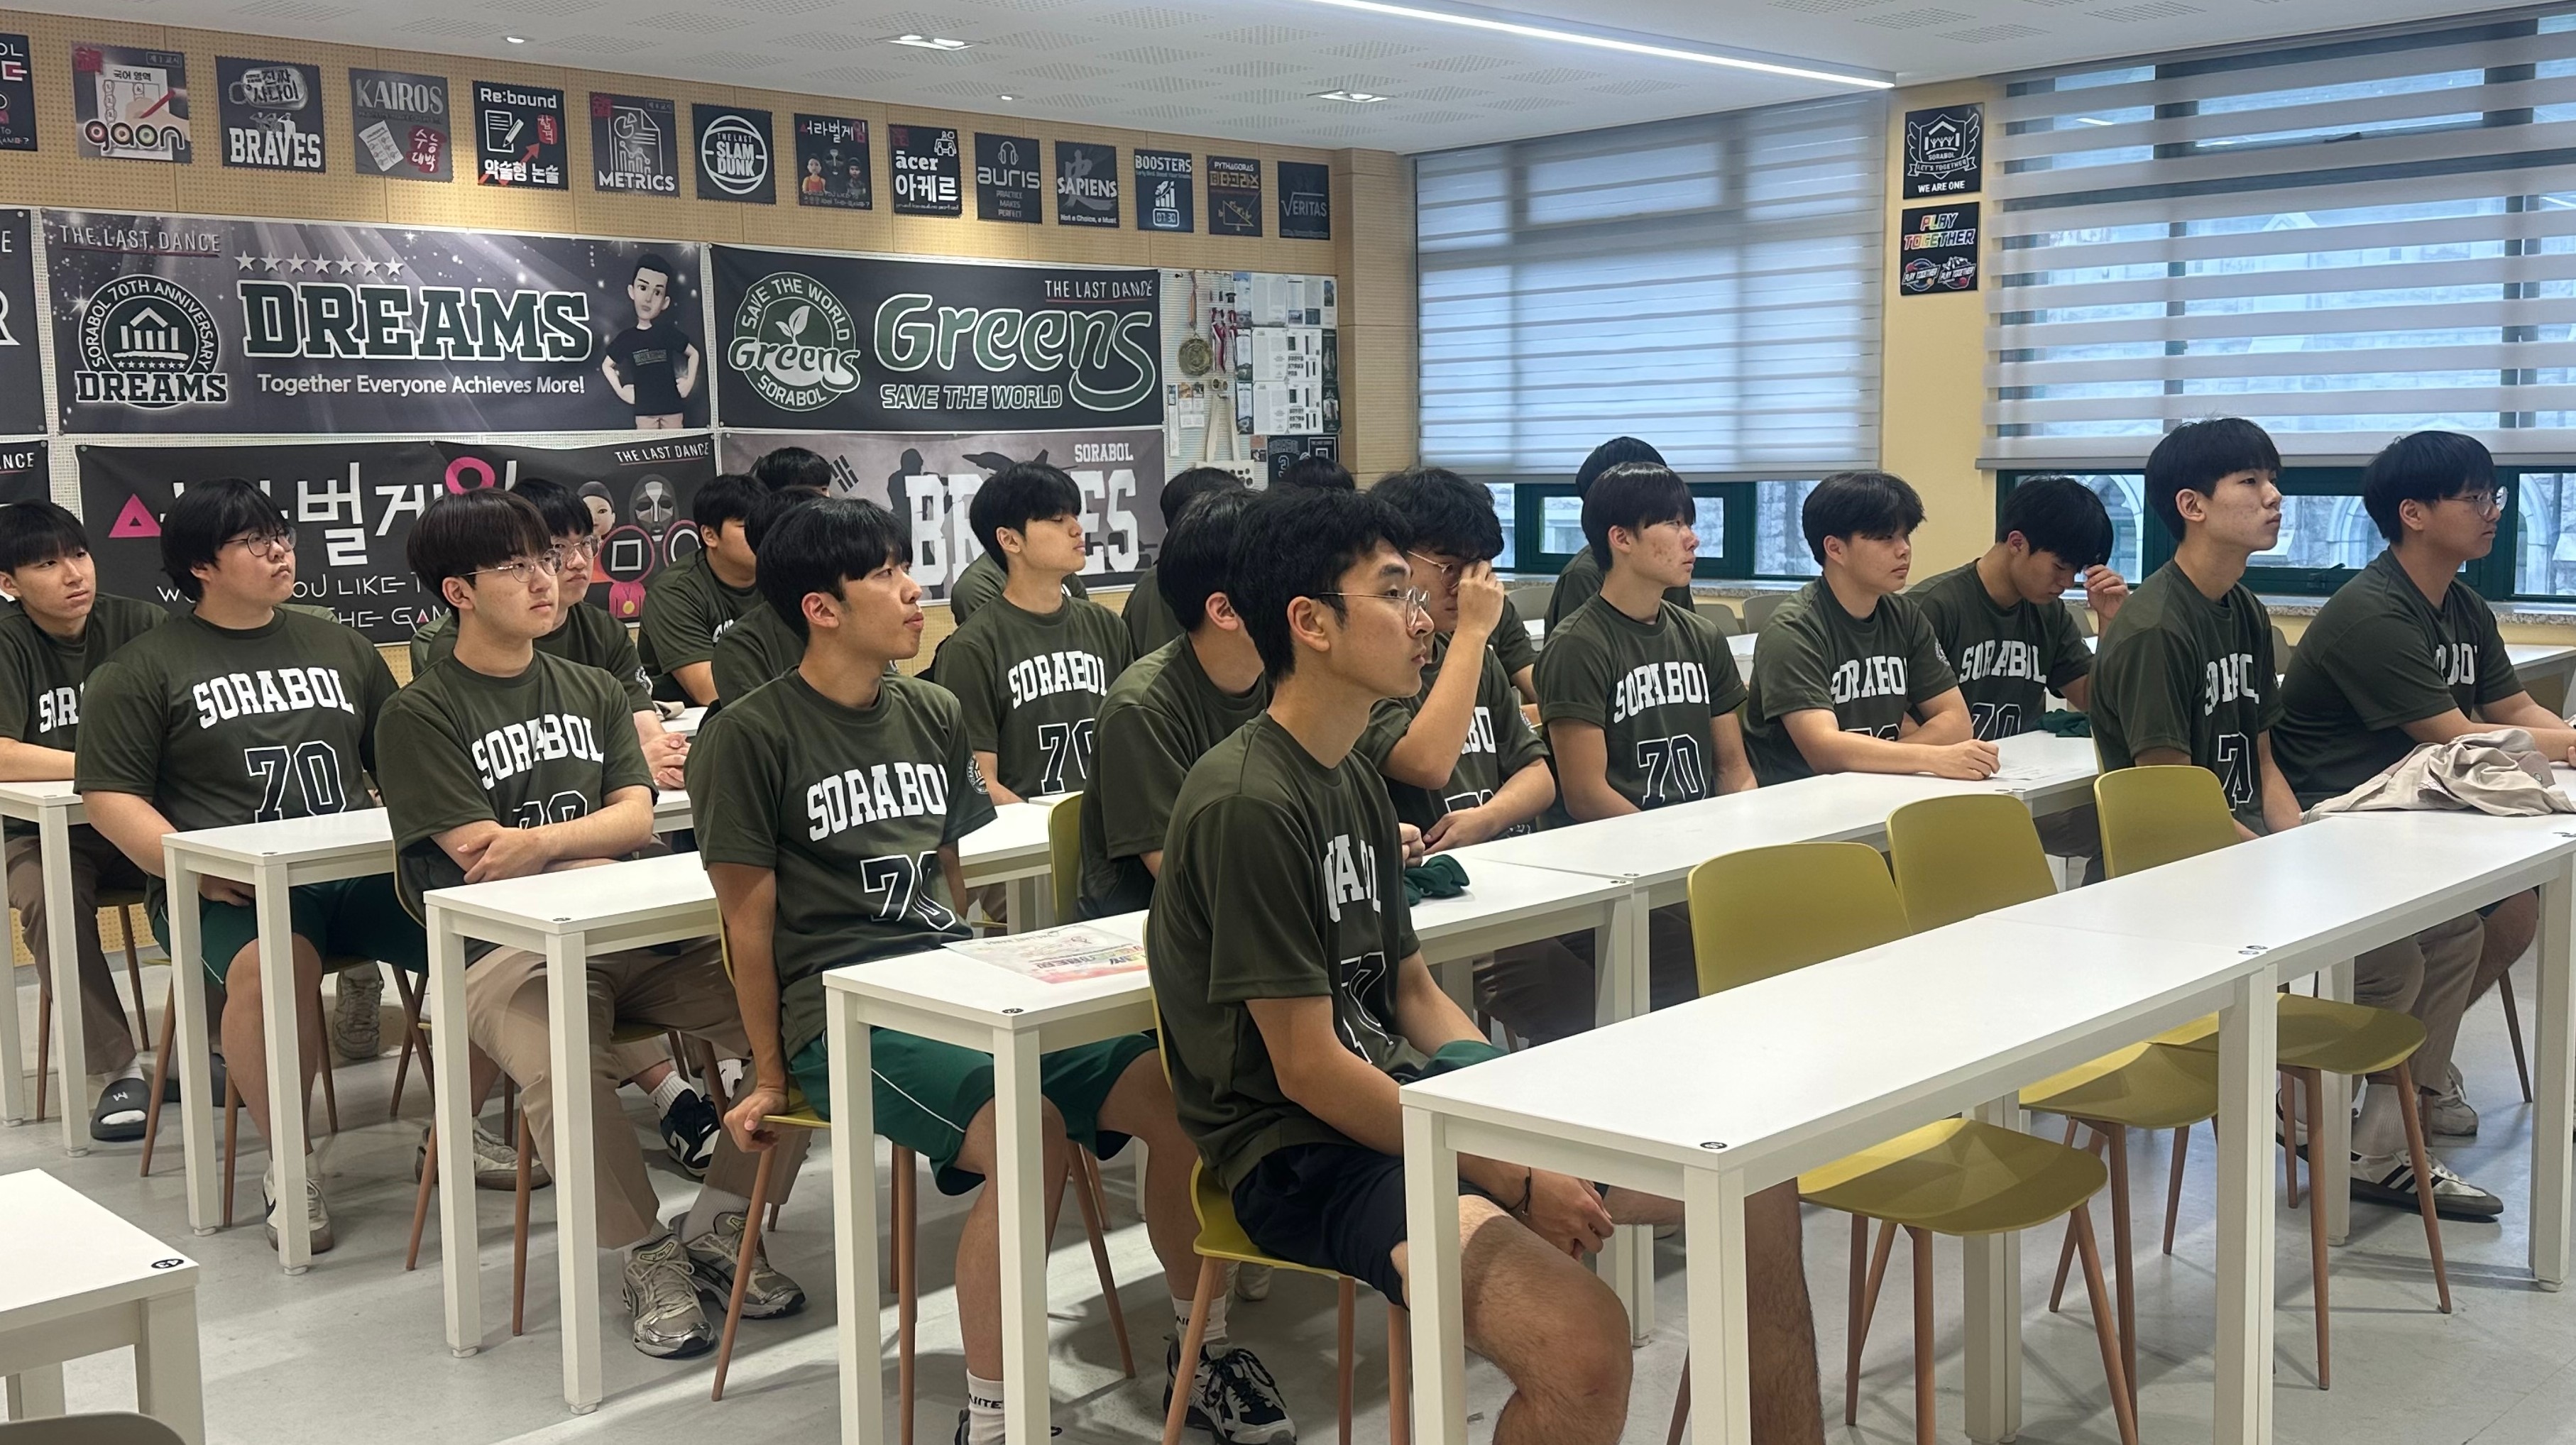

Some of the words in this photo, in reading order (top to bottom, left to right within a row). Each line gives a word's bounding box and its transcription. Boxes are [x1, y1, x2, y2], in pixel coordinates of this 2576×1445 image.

[114, 70, 131, 79] 국어
[262, 68, 291, 86] 진짜
[253, 80, 300, 102] 사나이
[356, 78, 444, 115] KAIROS
[480, 87, 557, 109] Re:bound
[229, 127, 322, 168] BRAVES
[414, 128, 439, 154] 수능
[717, 133, 732, 141] THE
[733, 134, 752, 143] LAST
[412, 151, 437, 172] 대박
[716, 141, 755, 160] SLAM
[484, 159, 527, 182] 약술형
[532, 163, 559, 185] 논술
[717, 157, 755, 177] DUNK
[1135, 155, 1192, 172] BOOSTERS
[1936, 159, 1967, 171] TOGETHER
[598, 170, 675, 192] METRICS
[895, 174, 958, 203] 아케르
[977, 166, 1041, 189] auris
[1057, 177, 1117, 198] SAPIENS
[1918, 185, 1931, 193] WE
[1931, 182, 1948, 192] ARE
[1949, 180, 1966, 190] ONE
[1920, 212, 1958, 231] PLAY
[60, 224, 94, 245] THE
[104, 231, 149, 250] LAST
[159, 232, 221, 252] DANCE
[1904, 229, 1976, 251] TOGETHER
[1045, 280, 1070, 297] THE
[1076, 280, 1107, 298] LAST
[1112, 280, 1153, 297] DANCE
[237, 280, 593, 362] DREAMS
[742, 286, 771, 329] SAVE
[771, 278, 804, 295] THE
[808, 283, 850, 341] WORLD
[85, 300, 111, 368] SORABOL
[107, 280, 150, 301] 70TH
[154, 282, 216, 371] ANNIVERSARY
[728, 336, 861, 393] Greens
[874, 294, 1156, 412] Greens
[75, 370, 229, 403] DREAMS
[257, 373, 351, 395] Together
[357, 375, 447, 397] Everyone
[451, 375, 532, 395] Achieves
[536, 376, 586, 394] More!
[757, 375, 827, 406] SORABOL
[880, 384, 939, 410] SAVE
[943, 385, 987, 410] THE
[993, 385, 1063, 410] WORLD
[0, 452, 35, 470] NCE
[615, 450, 640, 463] THE
[642, 446, 670, 461] LAST
[674, 442, 709, 458] DANCE
[1075, 443, 1134, 461] SORABOL
[905, 469, 1139, 586] BRES
[292, 573, 327, 598] OU
[337, 576, 406, 595] LIKE
[331, 607, 383, 627] HE
[192, 667, 355, 729] SORABOL
[1637, 733, 1706, 806] 70
[244, 740, 347, 823] 70
